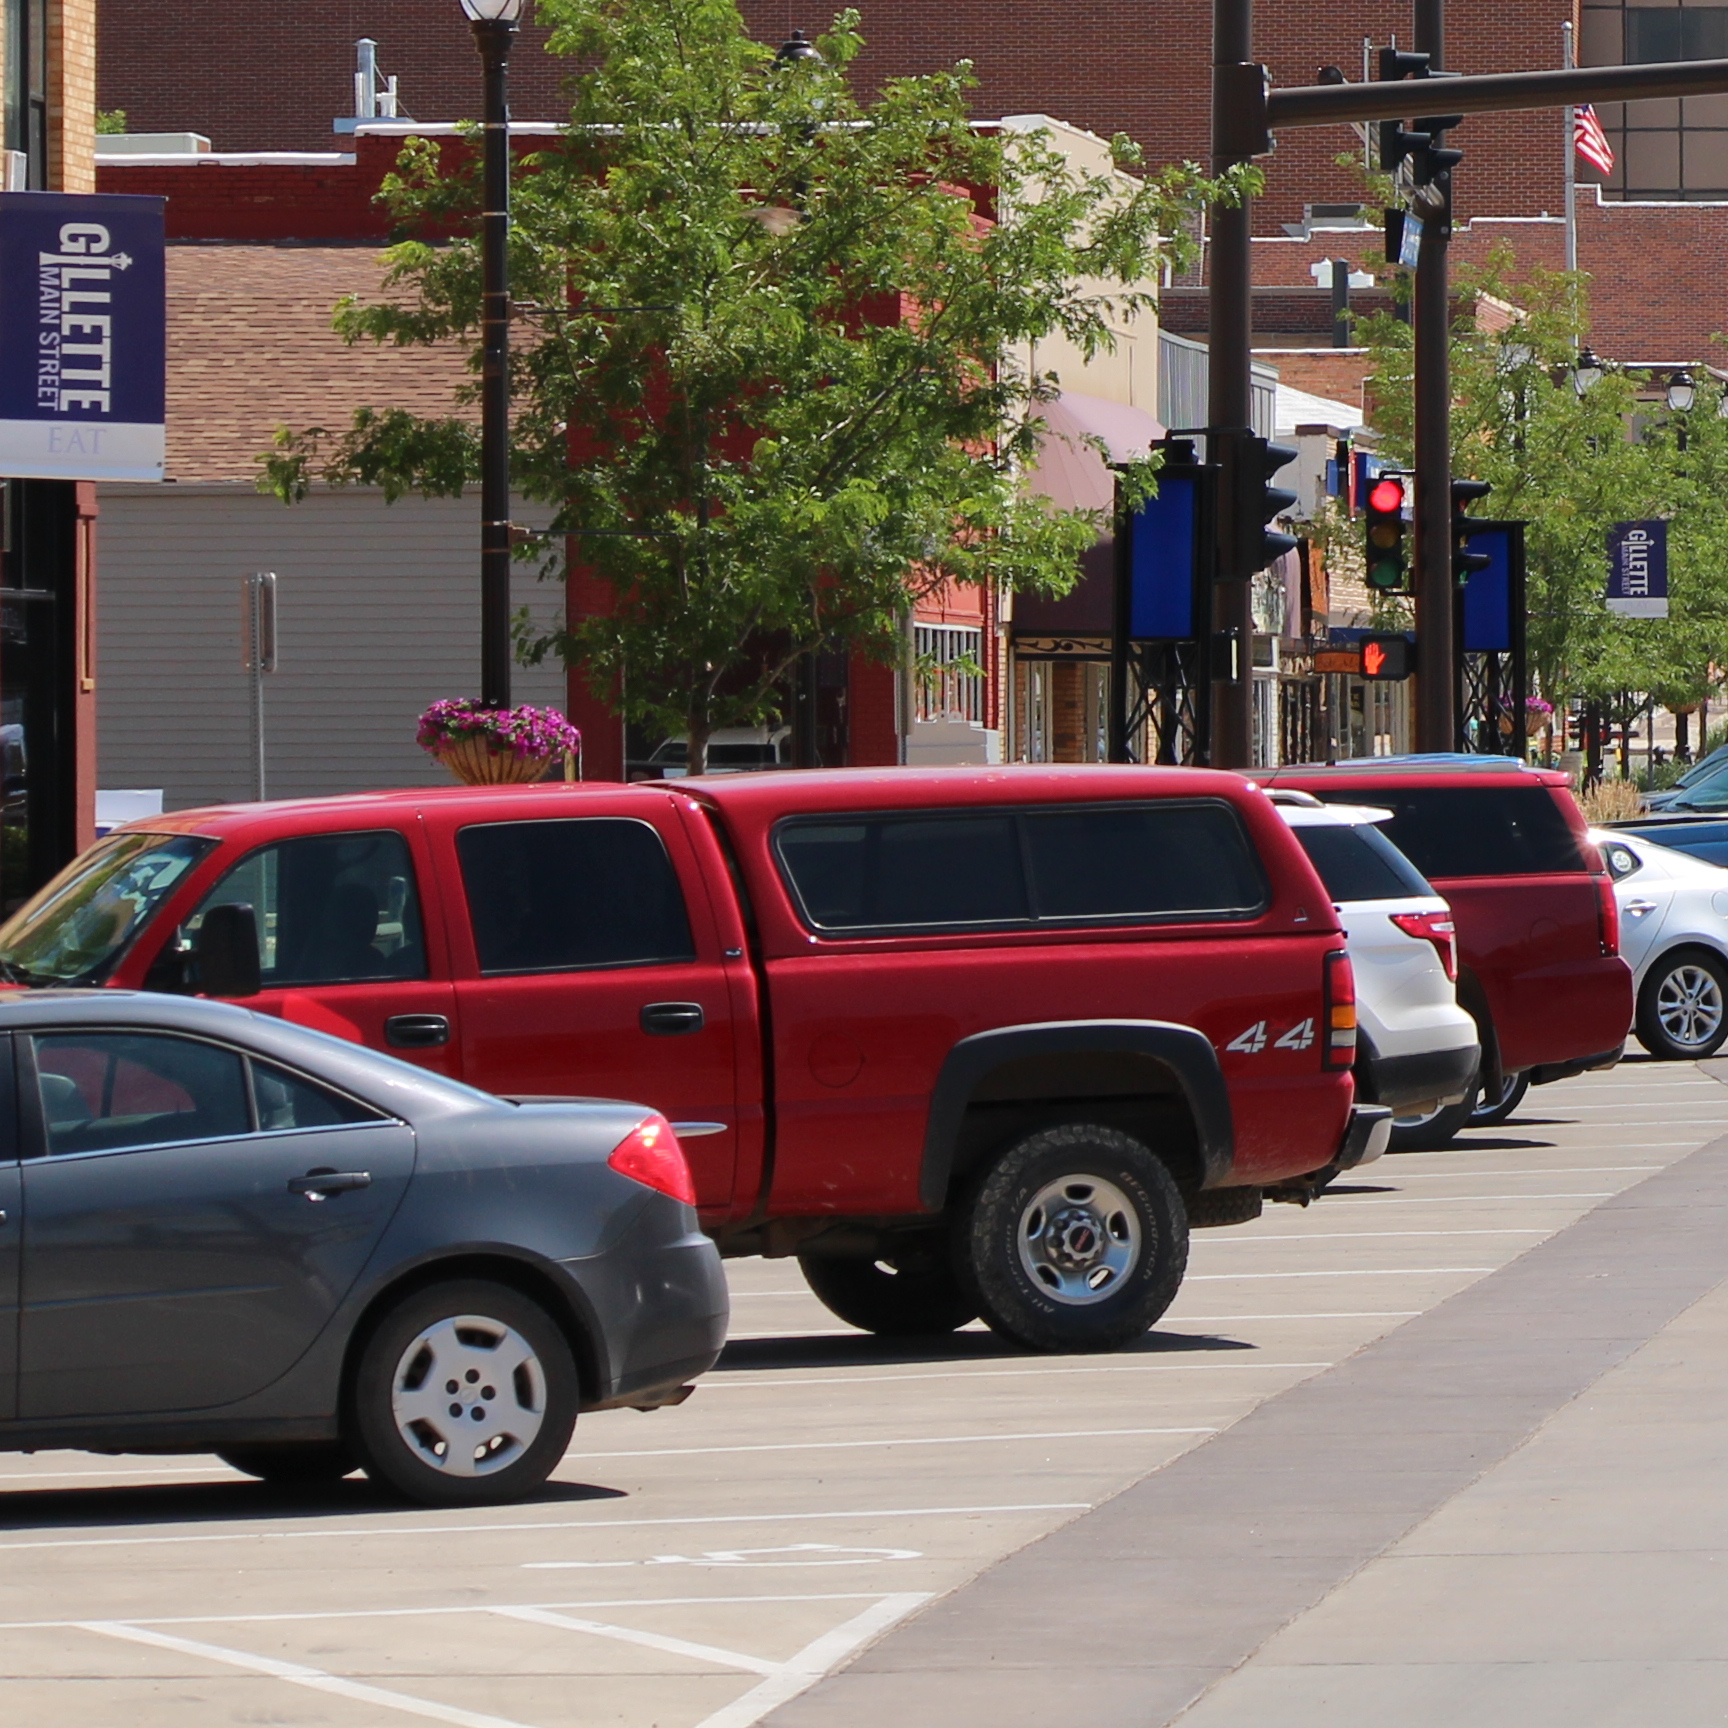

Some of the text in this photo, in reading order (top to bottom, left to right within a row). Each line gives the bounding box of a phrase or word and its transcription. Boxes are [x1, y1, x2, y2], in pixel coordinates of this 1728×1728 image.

[37, 266, 60, 412] MAIN STREET
[39, 222, 133, 413] GILLETTE
[47, 427, 107, 454] EAT
[1621, 529, 1655, 595] GILLETTE
